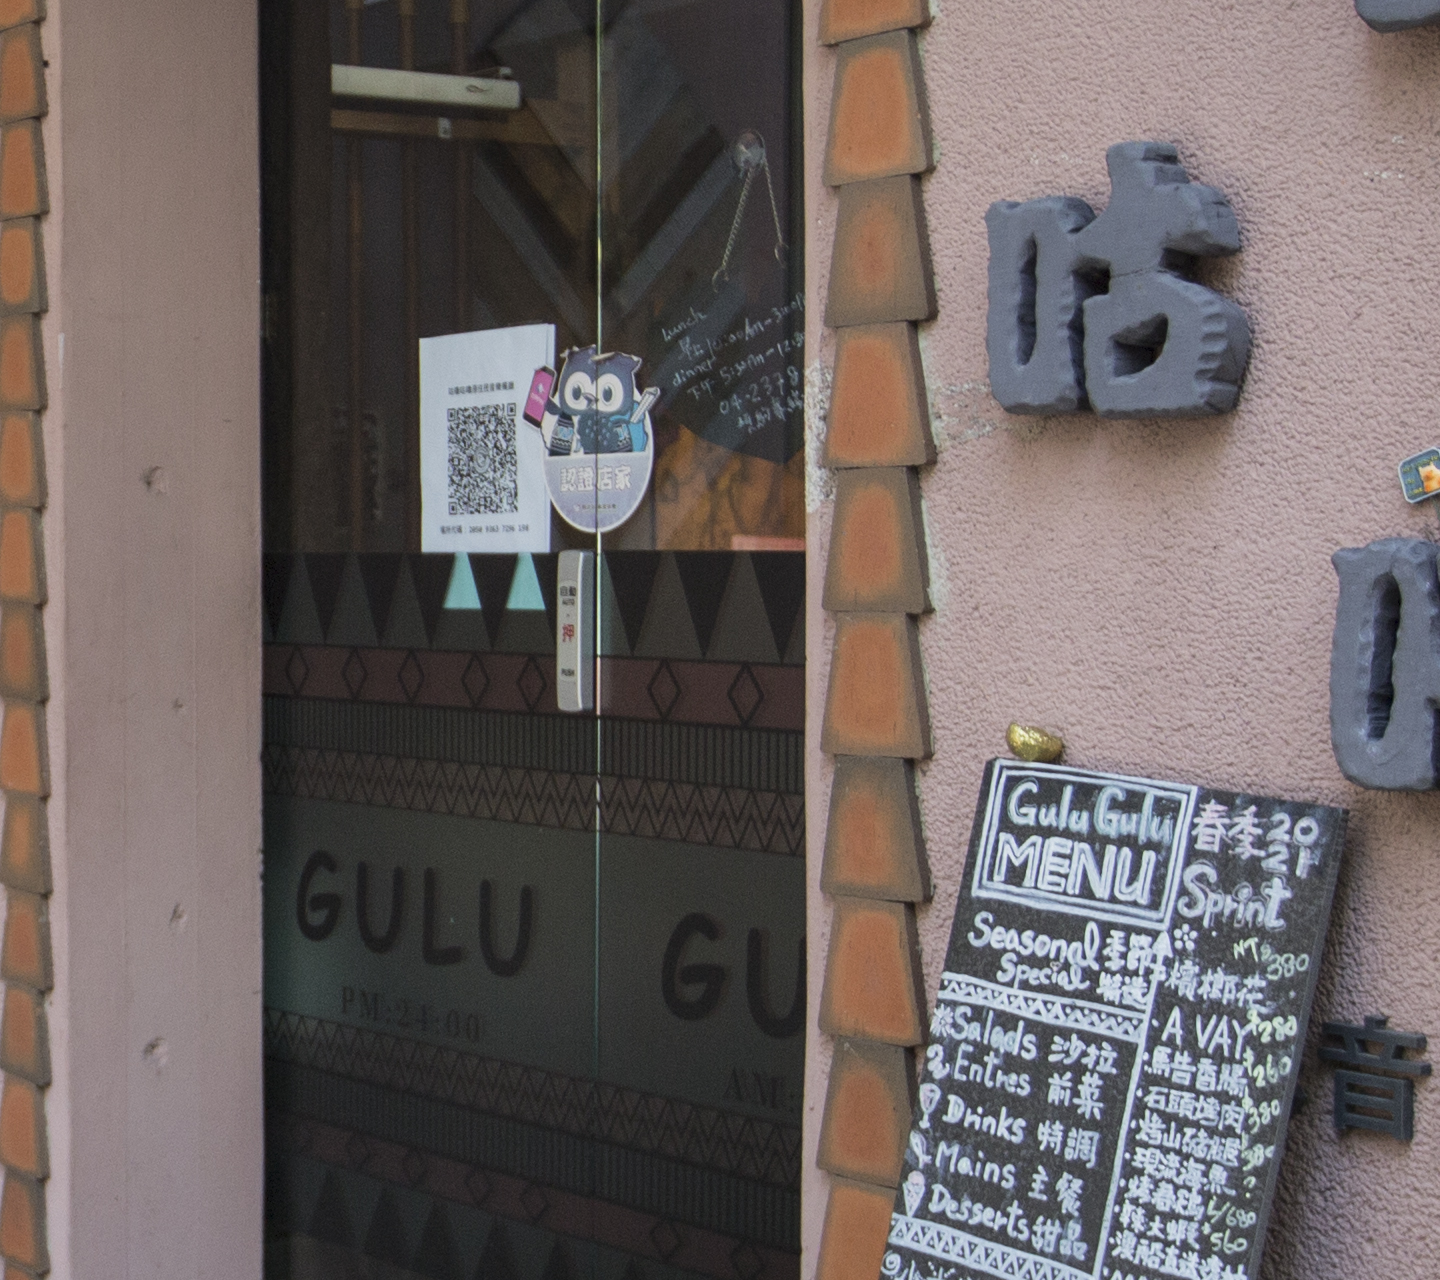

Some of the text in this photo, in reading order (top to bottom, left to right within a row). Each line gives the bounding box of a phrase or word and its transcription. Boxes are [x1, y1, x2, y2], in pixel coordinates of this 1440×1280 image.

[560, 466, 633, 492] 認證店家
[1007, 777, 1173, 845] Gulu Gulu
[1191, 798, 1266, 860] 春季
[993, 832, 1156, 905] MENU
[296, 849, 533, 979] GULU
[968, 911, 1099, 970] Seasonal
[996, 952, 1090, 991] Special
[950, 1005, 1118, 1075] Salads 沙拉
[1048, 1071, 1104, 1120] 前菜
[942, 1094, 1100, 1169] Drinks 特調
[935, 1140, 1084, 1217] Mains 主餐
[927, 1183, 1088, 1261] Desserts 甜品
